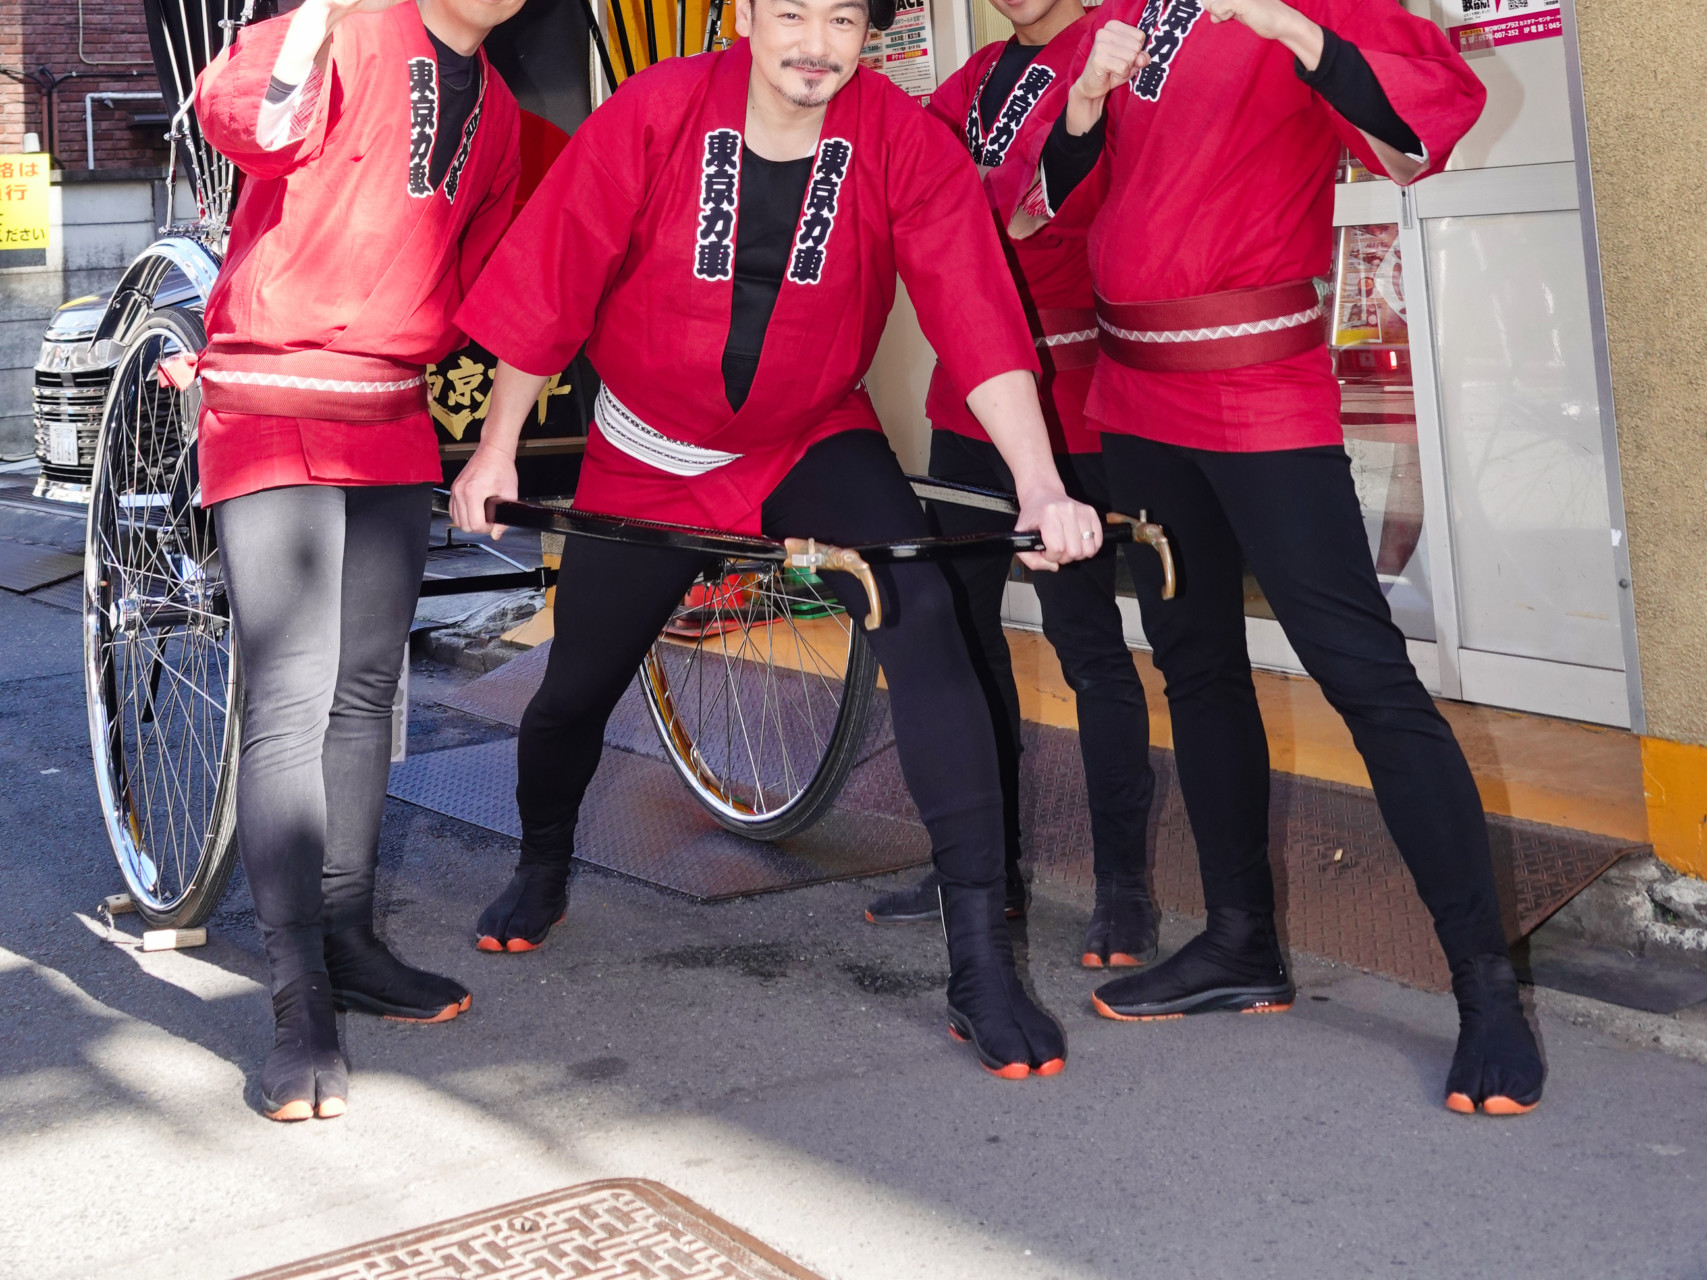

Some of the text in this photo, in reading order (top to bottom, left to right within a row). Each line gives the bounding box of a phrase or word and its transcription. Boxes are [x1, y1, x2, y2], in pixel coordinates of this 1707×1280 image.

[408, 57, 438, 198] 東京力車
[694, 128, 742, 282] 東京力車
[787, 137, 852, 285] 東京力車
